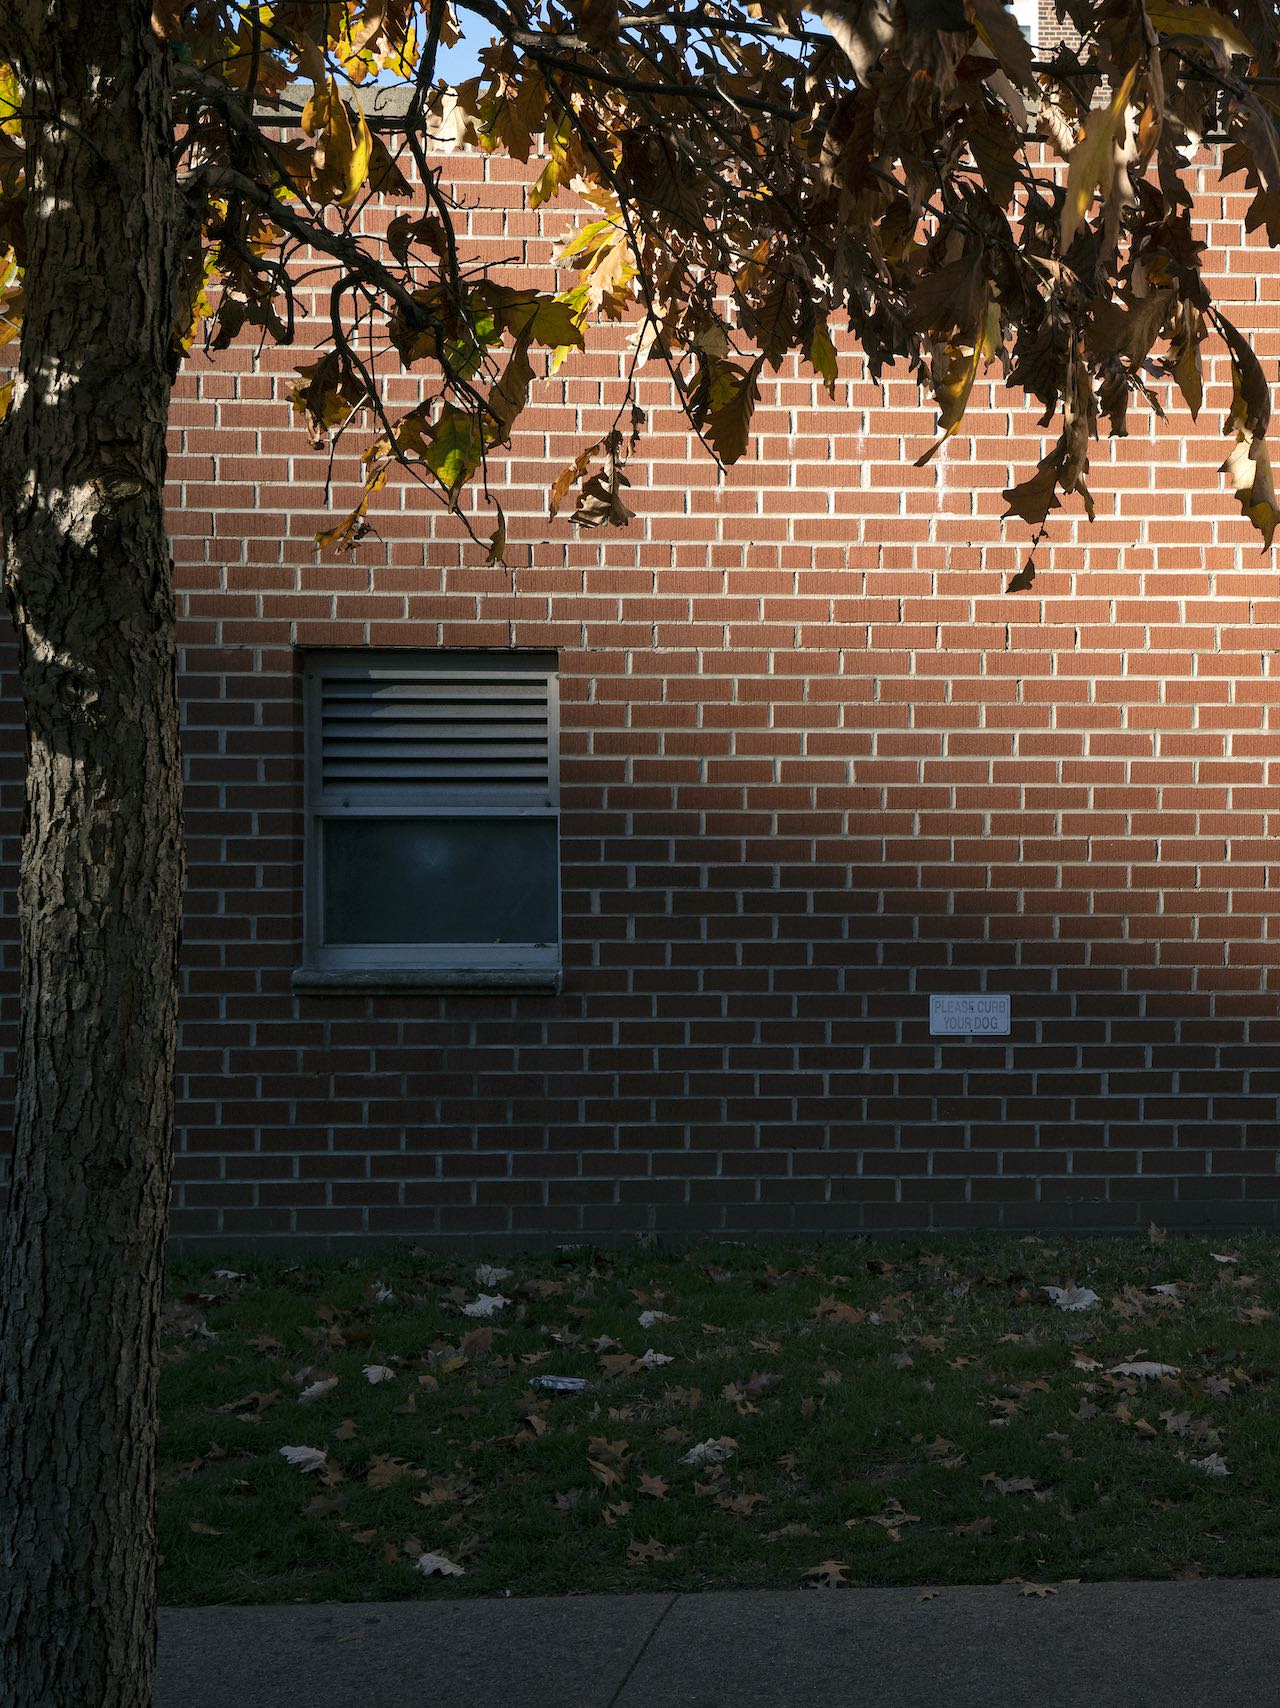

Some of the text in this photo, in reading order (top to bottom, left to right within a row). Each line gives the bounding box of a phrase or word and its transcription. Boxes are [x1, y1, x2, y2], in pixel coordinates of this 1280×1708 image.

[934, 1000, 1006, 1014] PLEASE CURB
[943, 1016, 998, 1030] YOUR DOG
